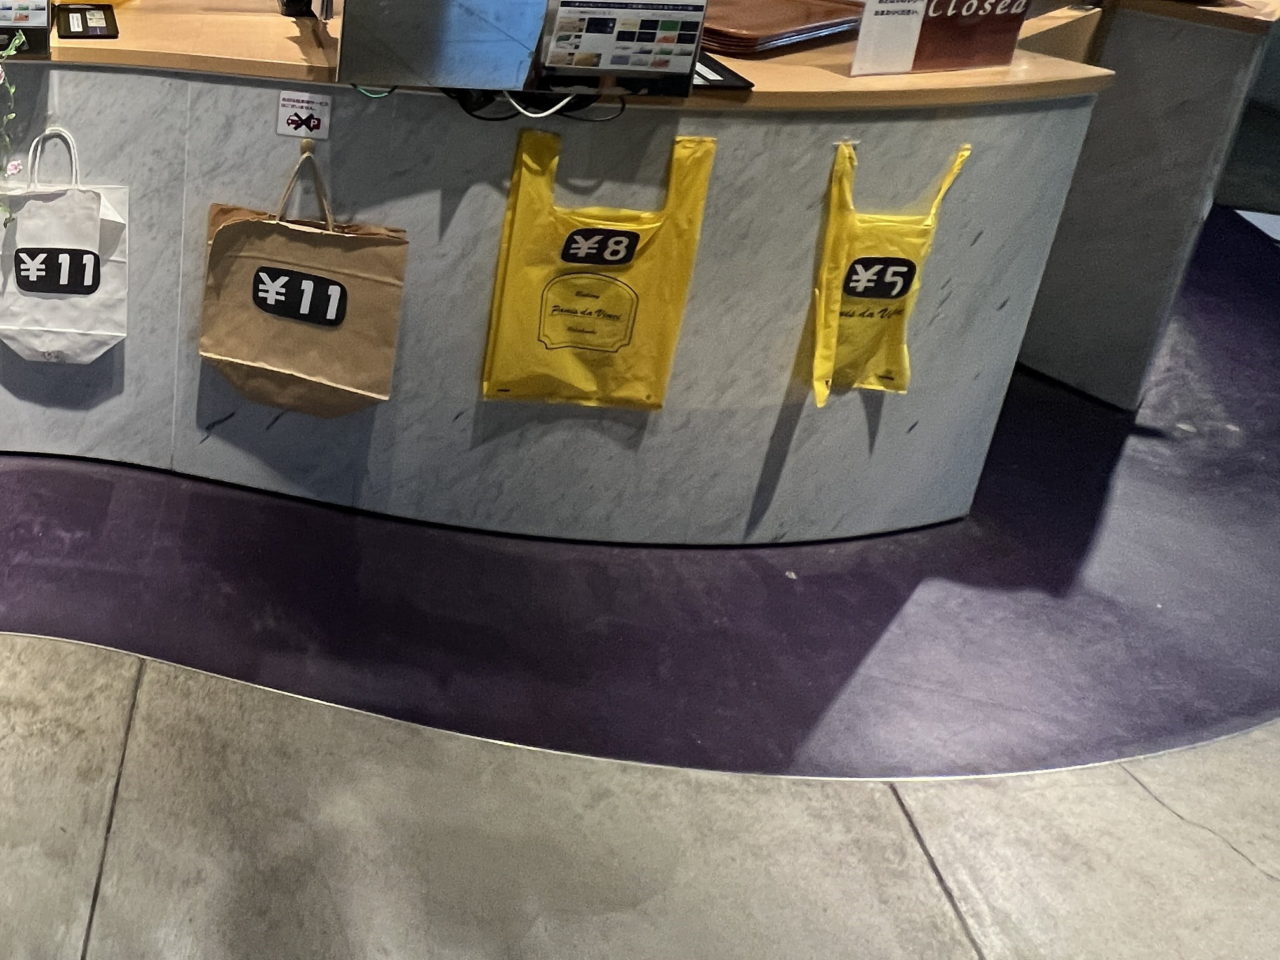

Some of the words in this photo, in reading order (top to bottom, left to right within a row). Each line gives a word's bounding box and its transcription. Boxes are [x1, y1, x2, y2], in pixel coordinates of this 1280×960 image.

[310, 119, 318, 128] P
[569, 235, 630, 260] ¥8
[18, 253, 94, 286] ¥11
[849, 264, 908, 296] ¥5
[258, 272, 342, 320] ¥11
[580, 308, 593, 316] da
[858, 308, 874, 318] da
